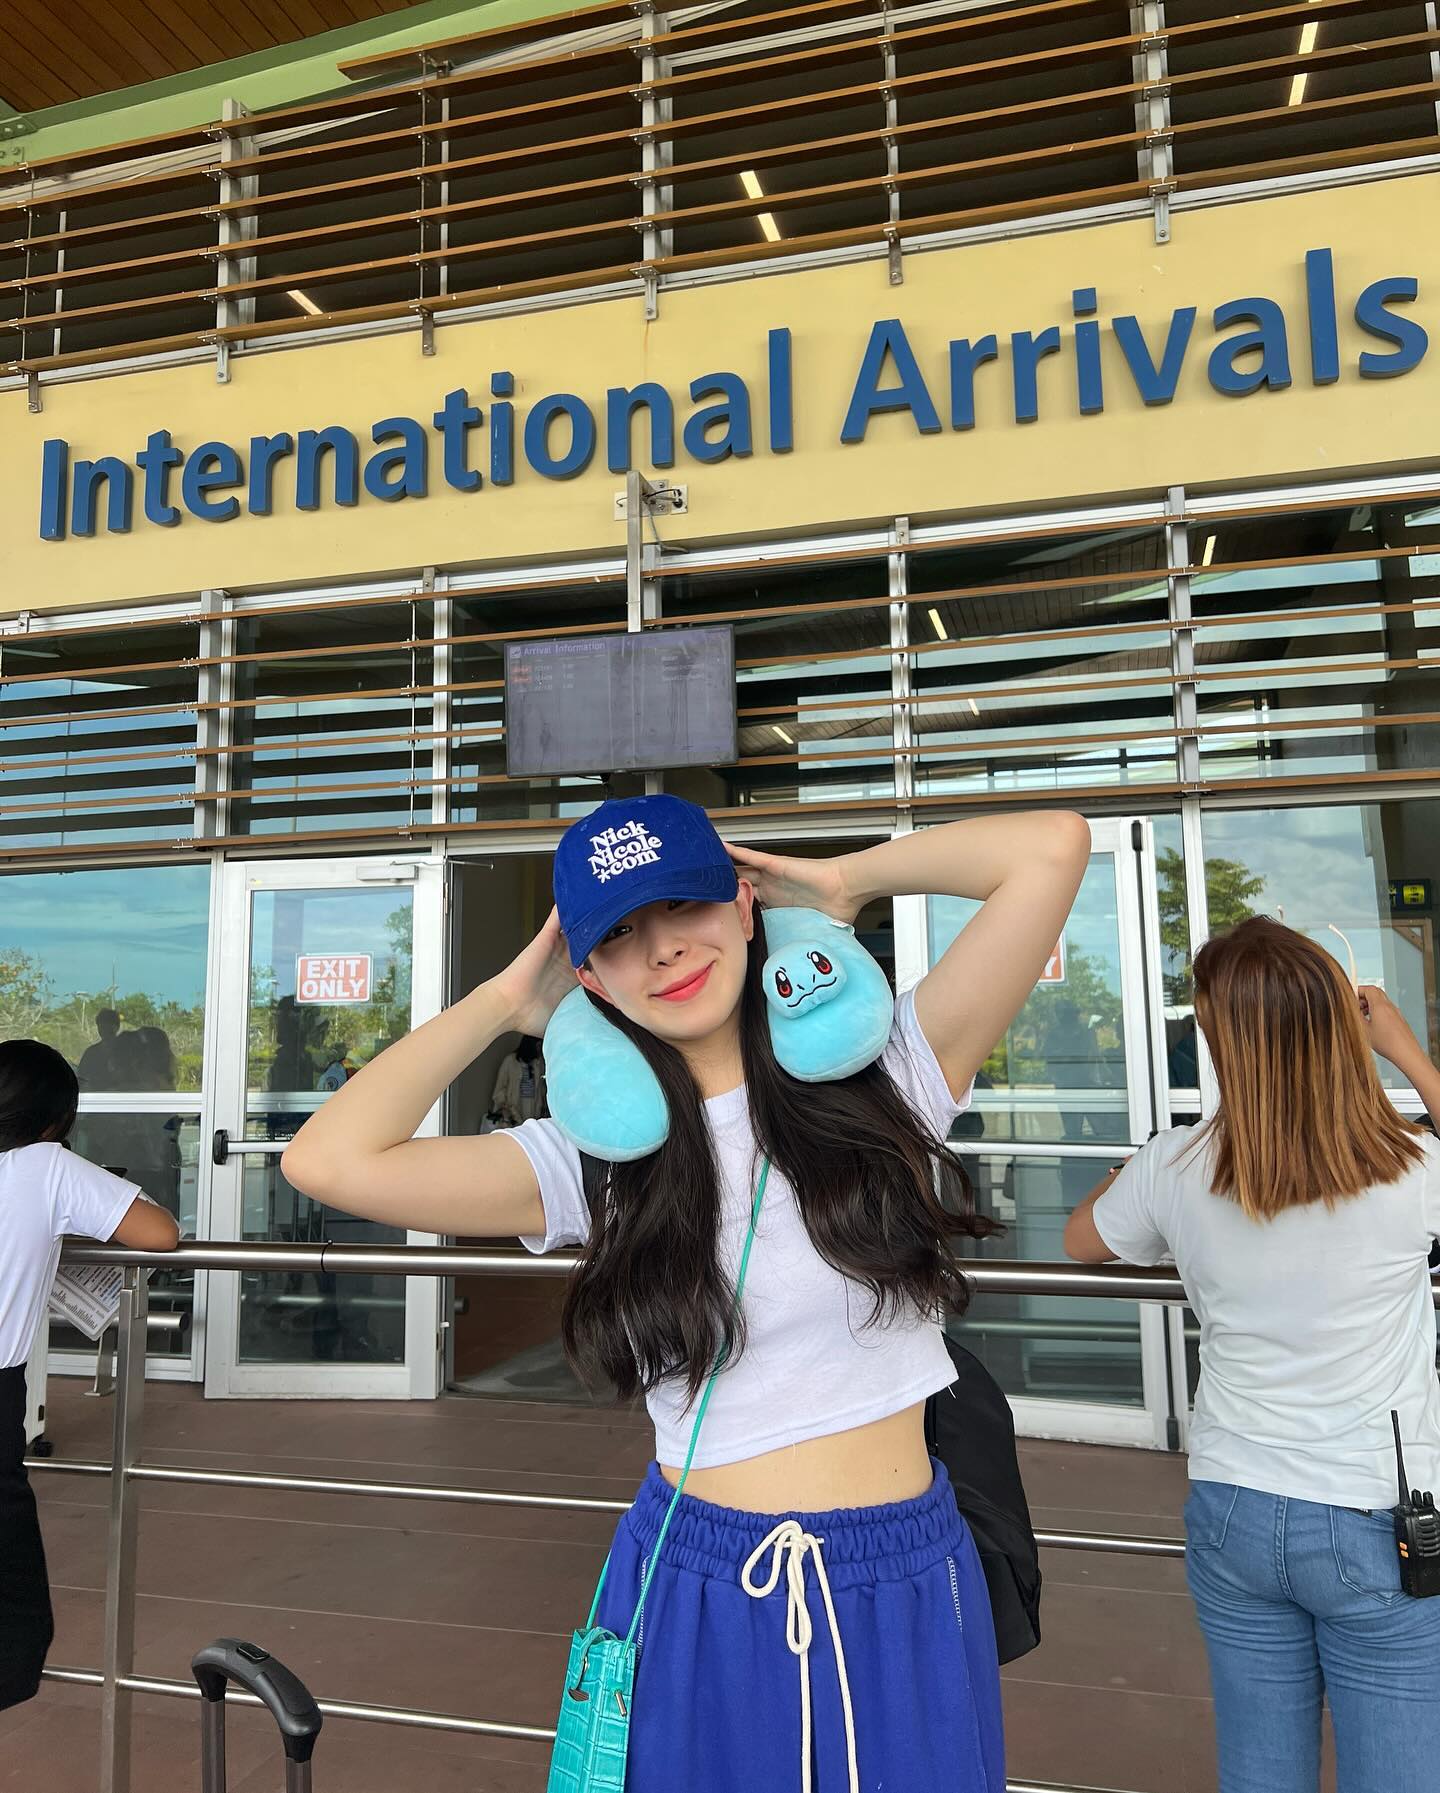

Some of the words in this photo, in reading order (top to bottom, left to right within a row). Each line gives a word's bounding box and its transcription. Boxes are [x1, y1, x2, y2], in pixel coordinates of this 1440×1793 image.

[39, 328, 793, 541] International
[840, 247, 1428, 444] Arrivals
[523, 646, 552, 656] Arrival
[555, 642, 606, 654] Information
[589, 820, 650, 855] Nick
[587, 834, 663, 875] Nicole
[307, 959, 361, 979] EXIT
[302, 979, 365, 999] ONLY
